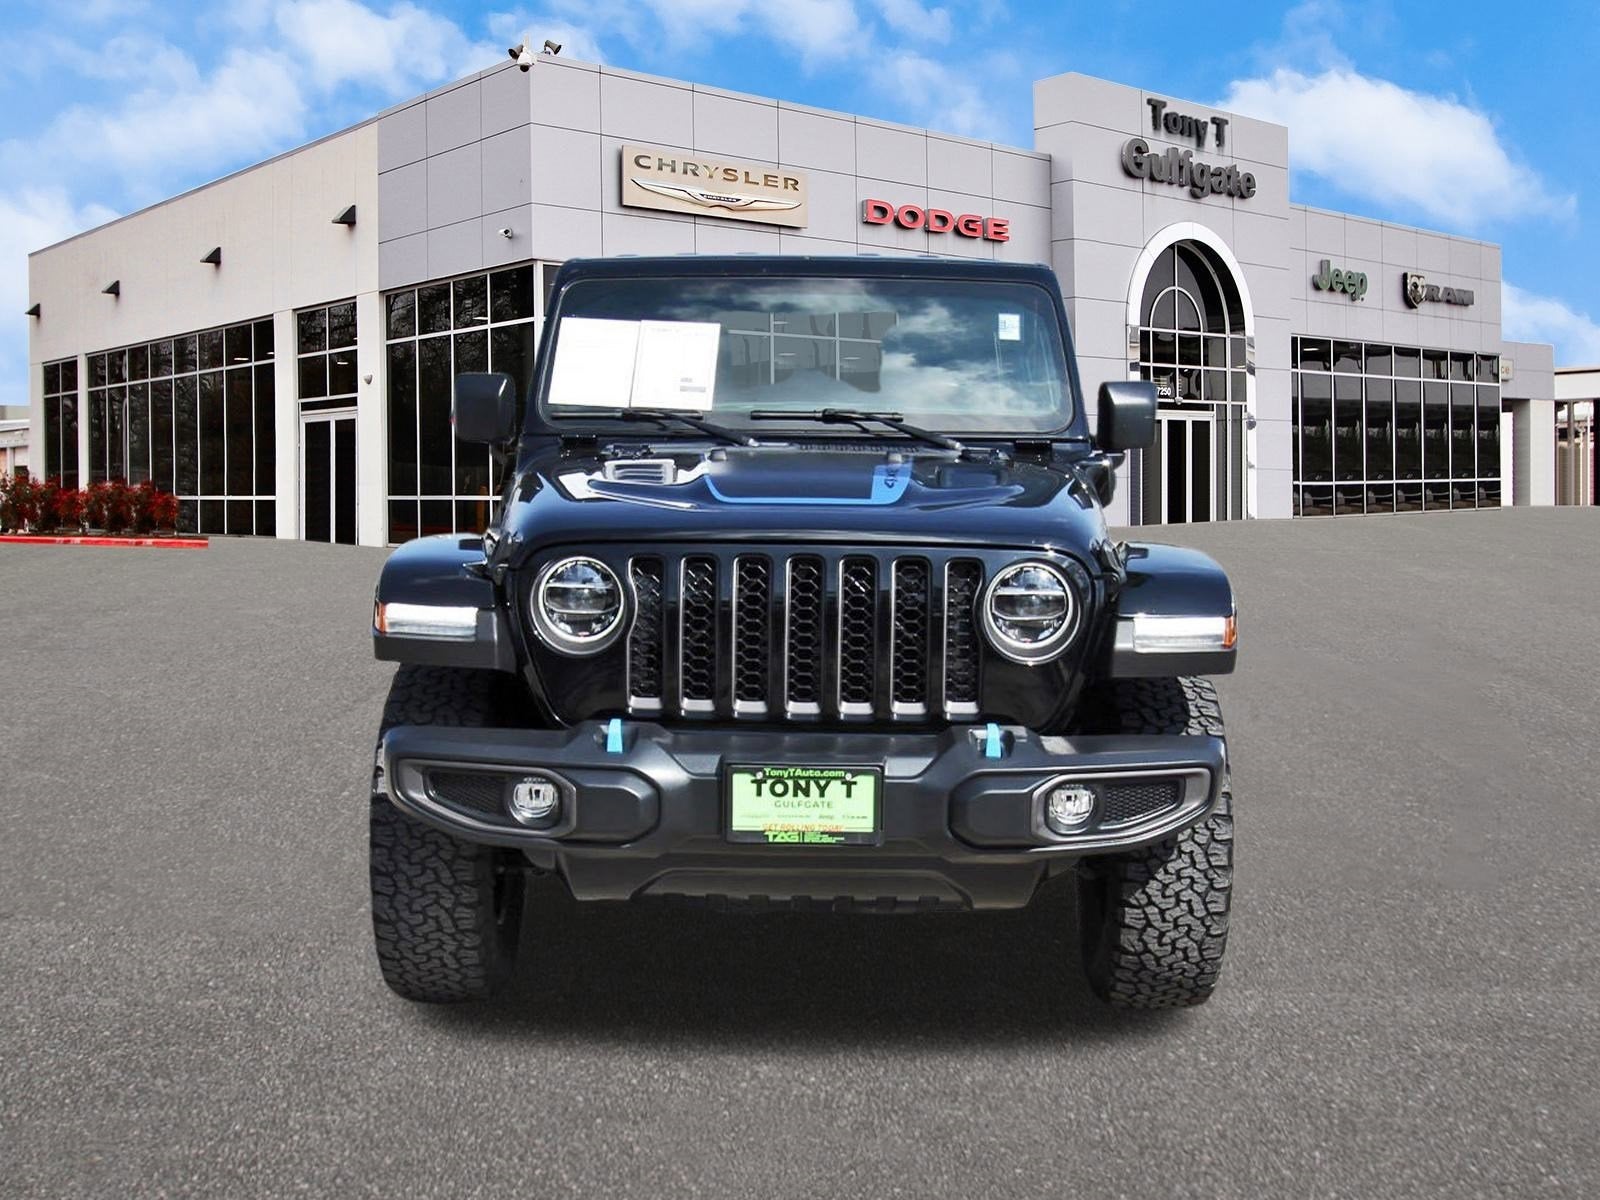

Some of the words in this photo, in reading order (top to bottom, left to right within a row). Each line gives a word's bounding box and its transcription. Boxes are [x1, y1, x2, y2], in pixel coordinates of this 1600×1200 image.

[1147, 98, 1209, 147] Tony
[1210, 117, 1229, 147] T
[634, 154, 799, 191] CHRYSLER
[1122, 138, 1256, 198] Gulfgate
[862, 199, 1010, 241] DODGE
[1312, 260, 1368, 302] Jeep
[1424, 284, 1475, 306] RAM
[1156, 387, 1171, 396] 7250
[751, 779, 831, 798] TONY
[841, 781, 857, 798] T
[774, 800, 833, 809] GULFGATE
